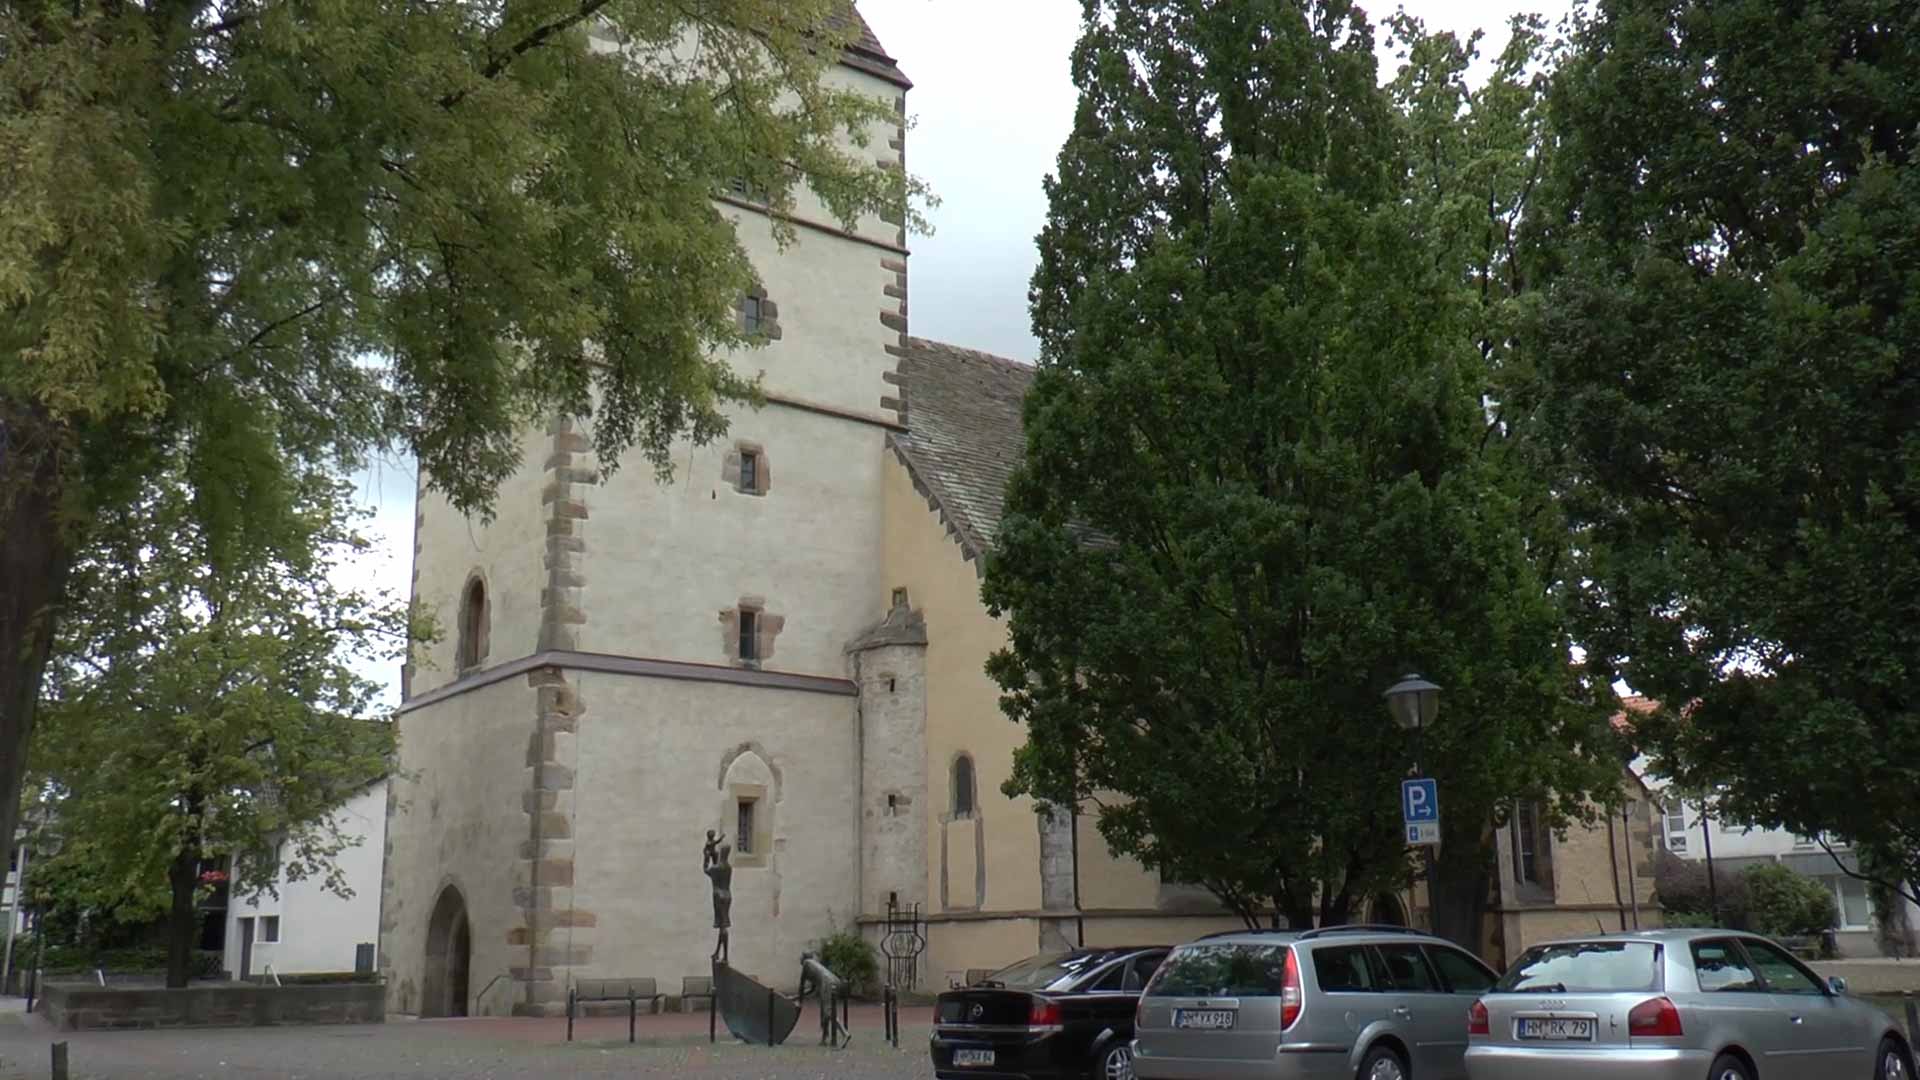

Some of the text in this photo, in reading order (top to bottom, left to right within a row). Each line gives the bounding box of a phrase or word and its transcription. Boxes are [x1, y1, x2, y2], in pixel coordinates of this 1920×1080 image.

[1408, 786, 1426, 817] P
[1550, 1021, 1566, 1034] RK
[1572, 1021, 1588, 1034] 79
